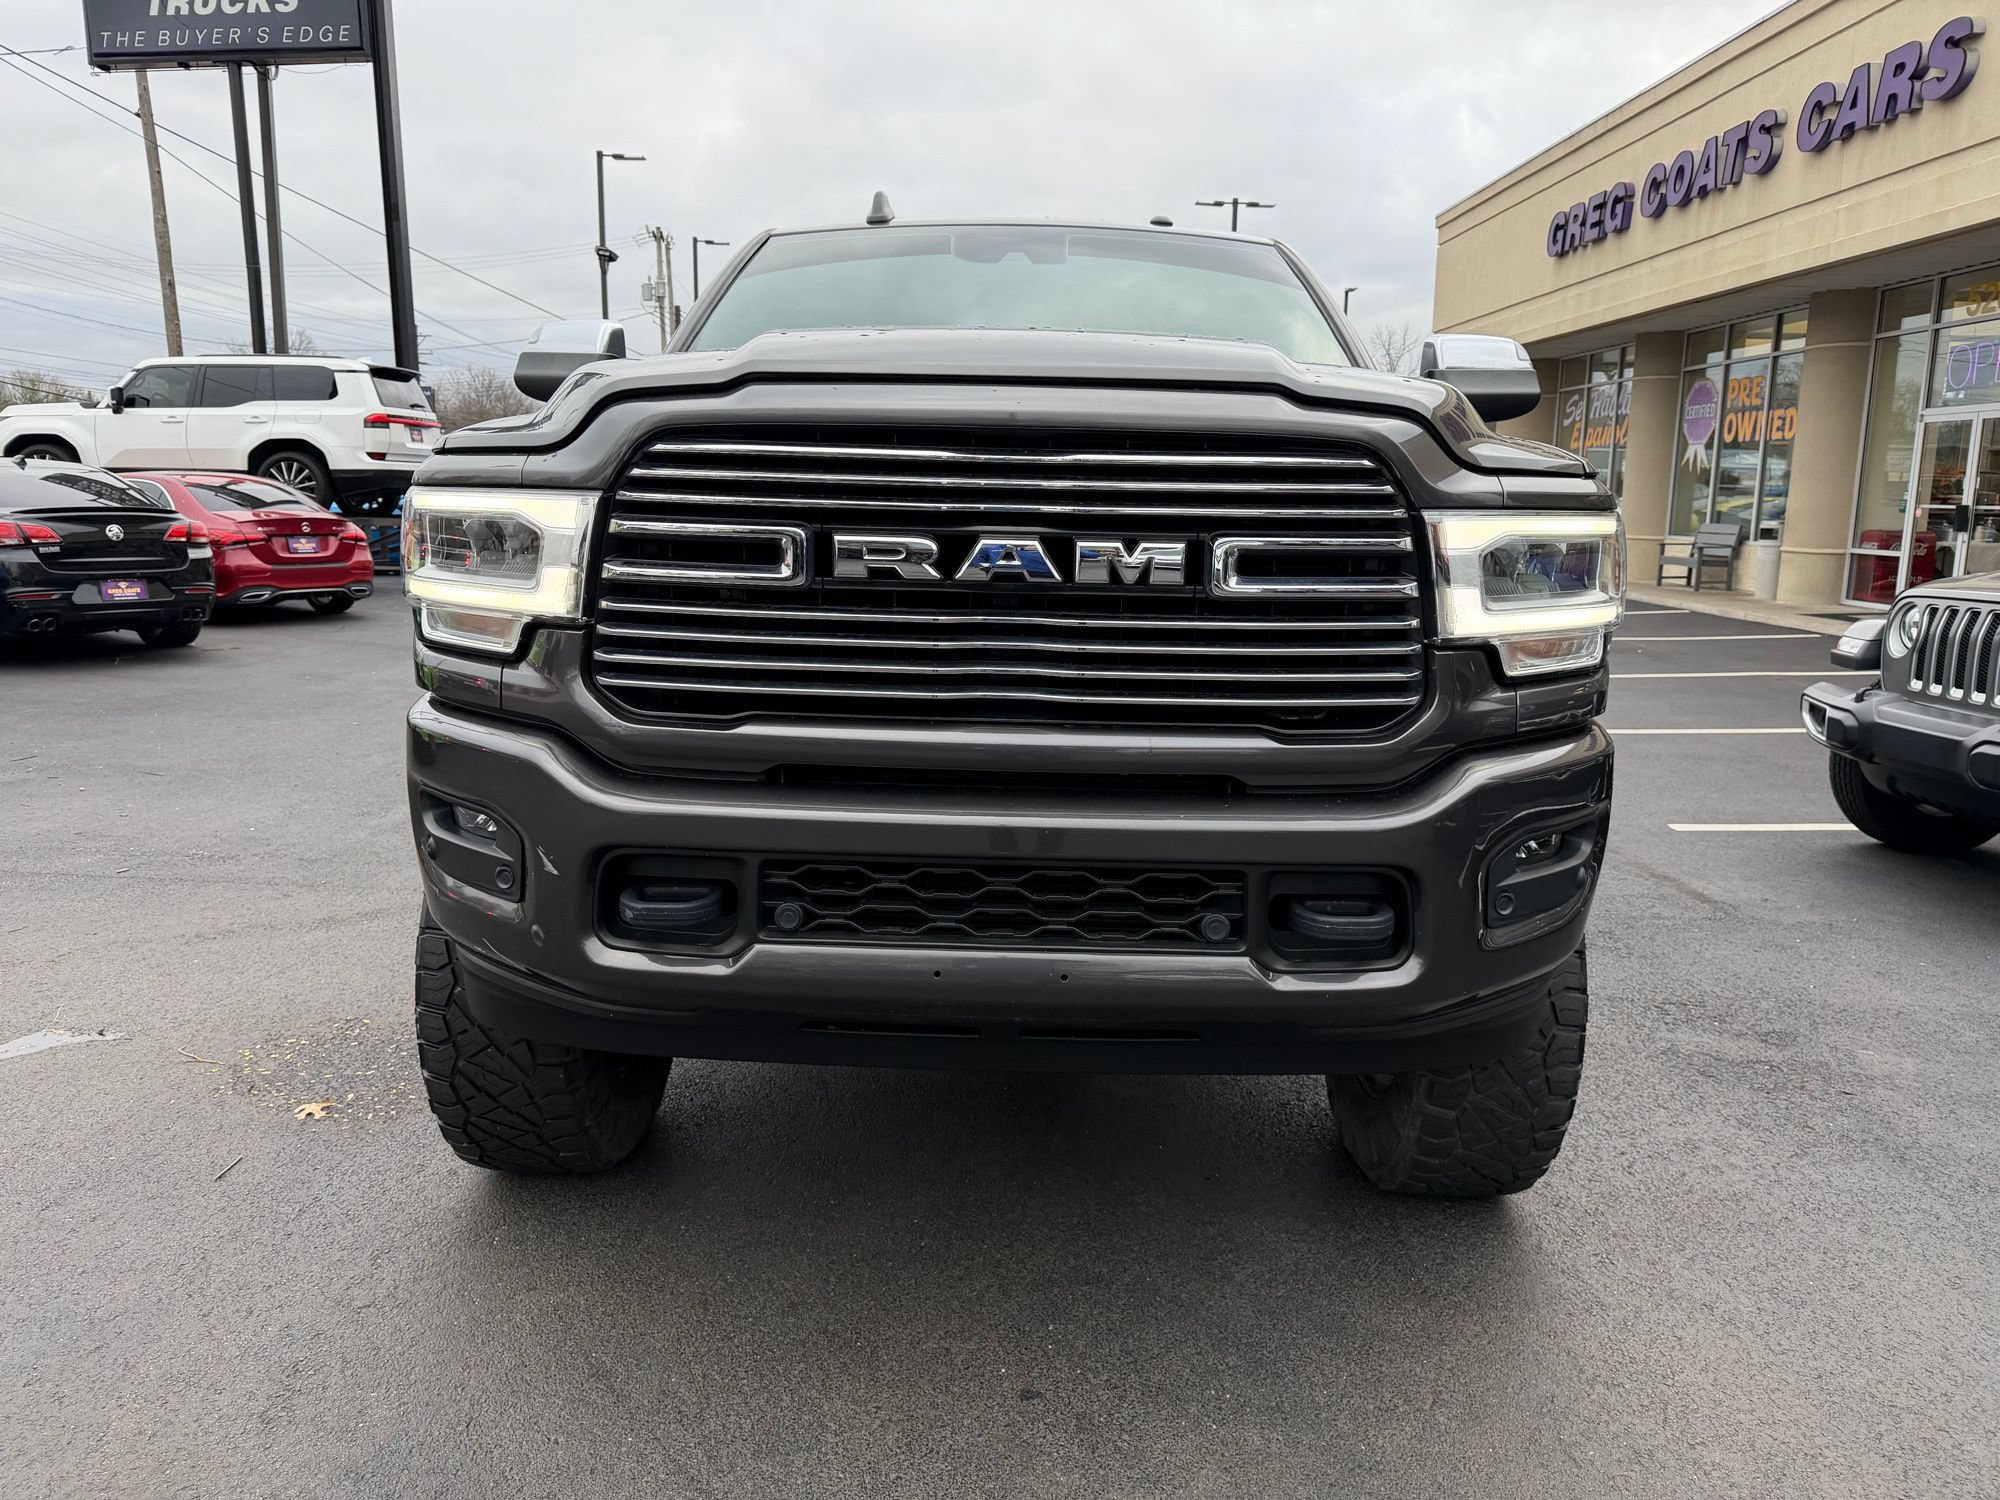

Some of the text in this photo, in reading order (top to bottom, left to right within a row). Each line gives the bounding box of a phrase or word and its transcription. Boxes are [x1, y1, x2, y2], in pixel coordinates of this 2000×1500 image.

[100, 25, 351, 48] THE BUYER'S EDGE
[1547, 15, 1986, 257] GREG COATS CARS
[1685, 403, 1716, 419] CERTIFIED
[1723, 407, 1798, 443] OWNED
[833, 532, 1187, 585] RAM
